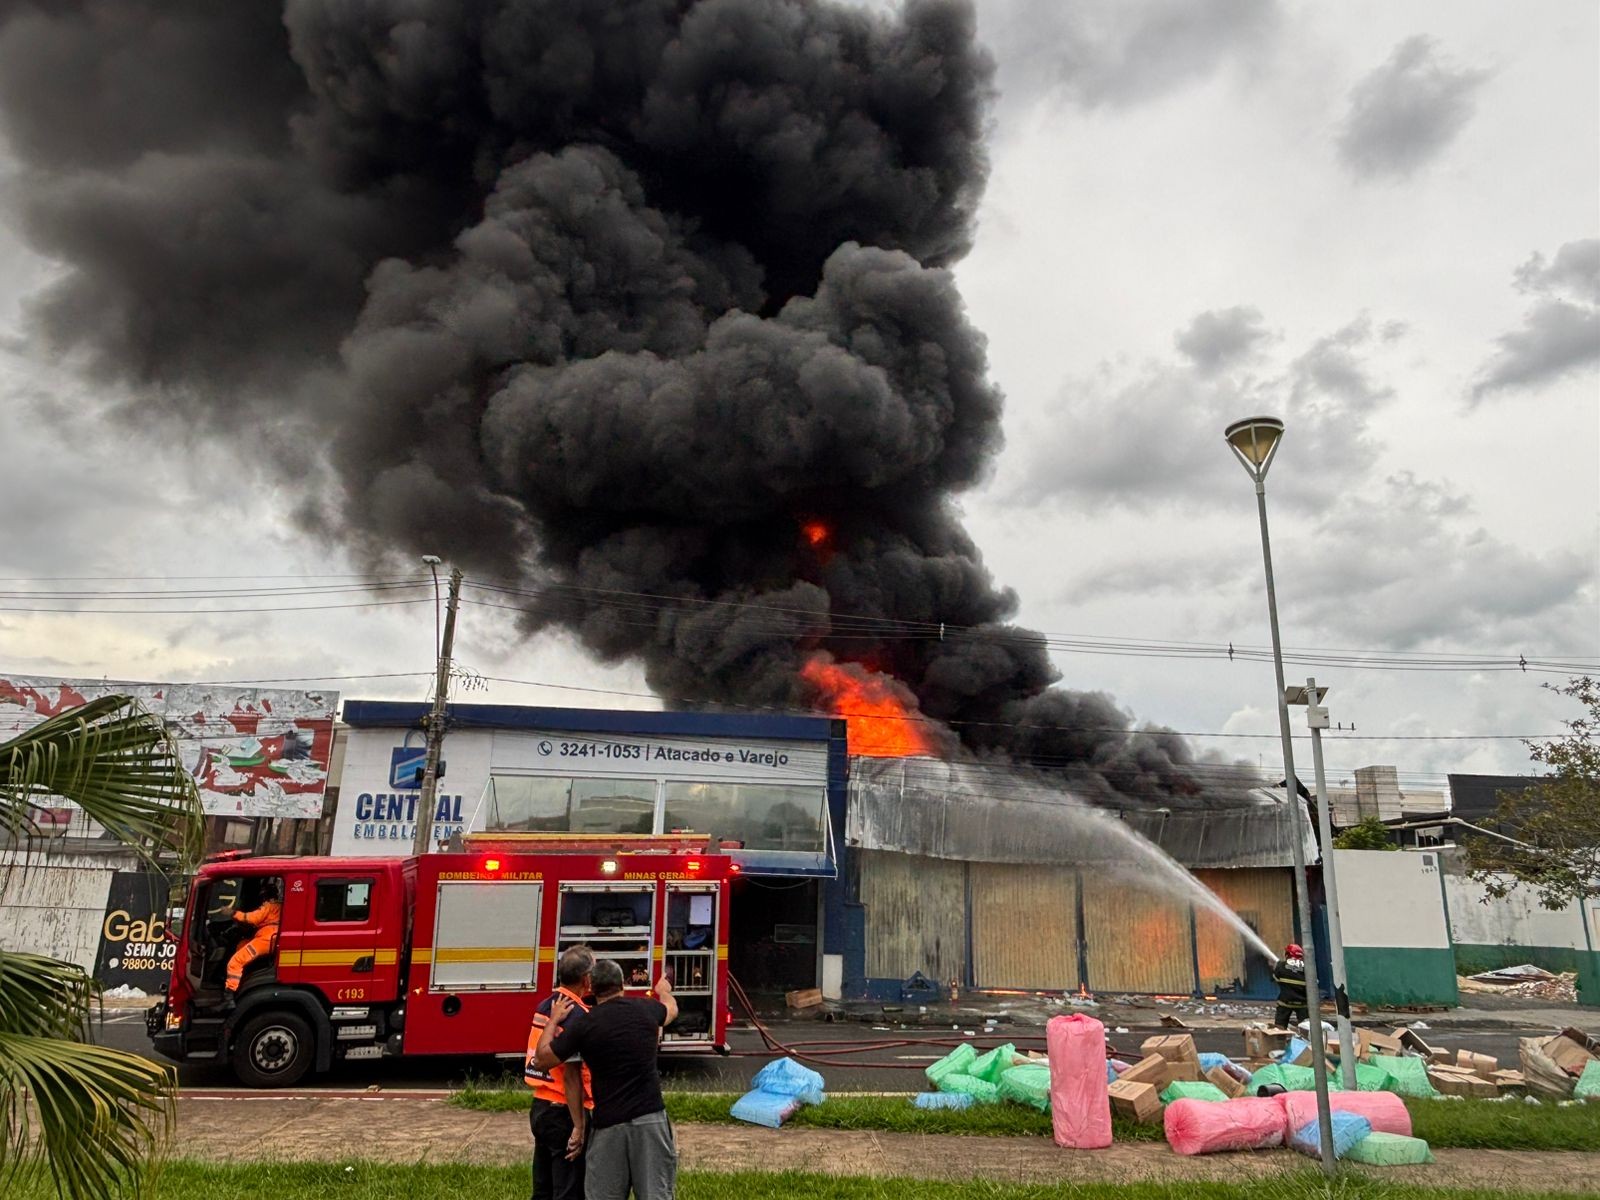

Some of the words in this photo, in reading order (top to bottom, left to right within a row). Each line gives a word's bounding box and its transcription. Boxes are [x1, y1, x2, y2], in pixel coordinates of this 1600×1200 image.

[560, 743, 640, 760] 3241-1053
[654, 746, 720, 763] Atacado
[725, 752, 734, 763] e
[739, 749, 789, 768] Varejo
[355, 792, 464, 822] CENTAL
[501, 871, 543, 880] MILITAR
[624, 871, 656, 880] MINAS
[658, 871, 696, 880] GERAIS
[104, 909, 166, 943] Gab
[124, 942, 156, 957] SEMI
[122, 958, 175, 971] 98800-60
